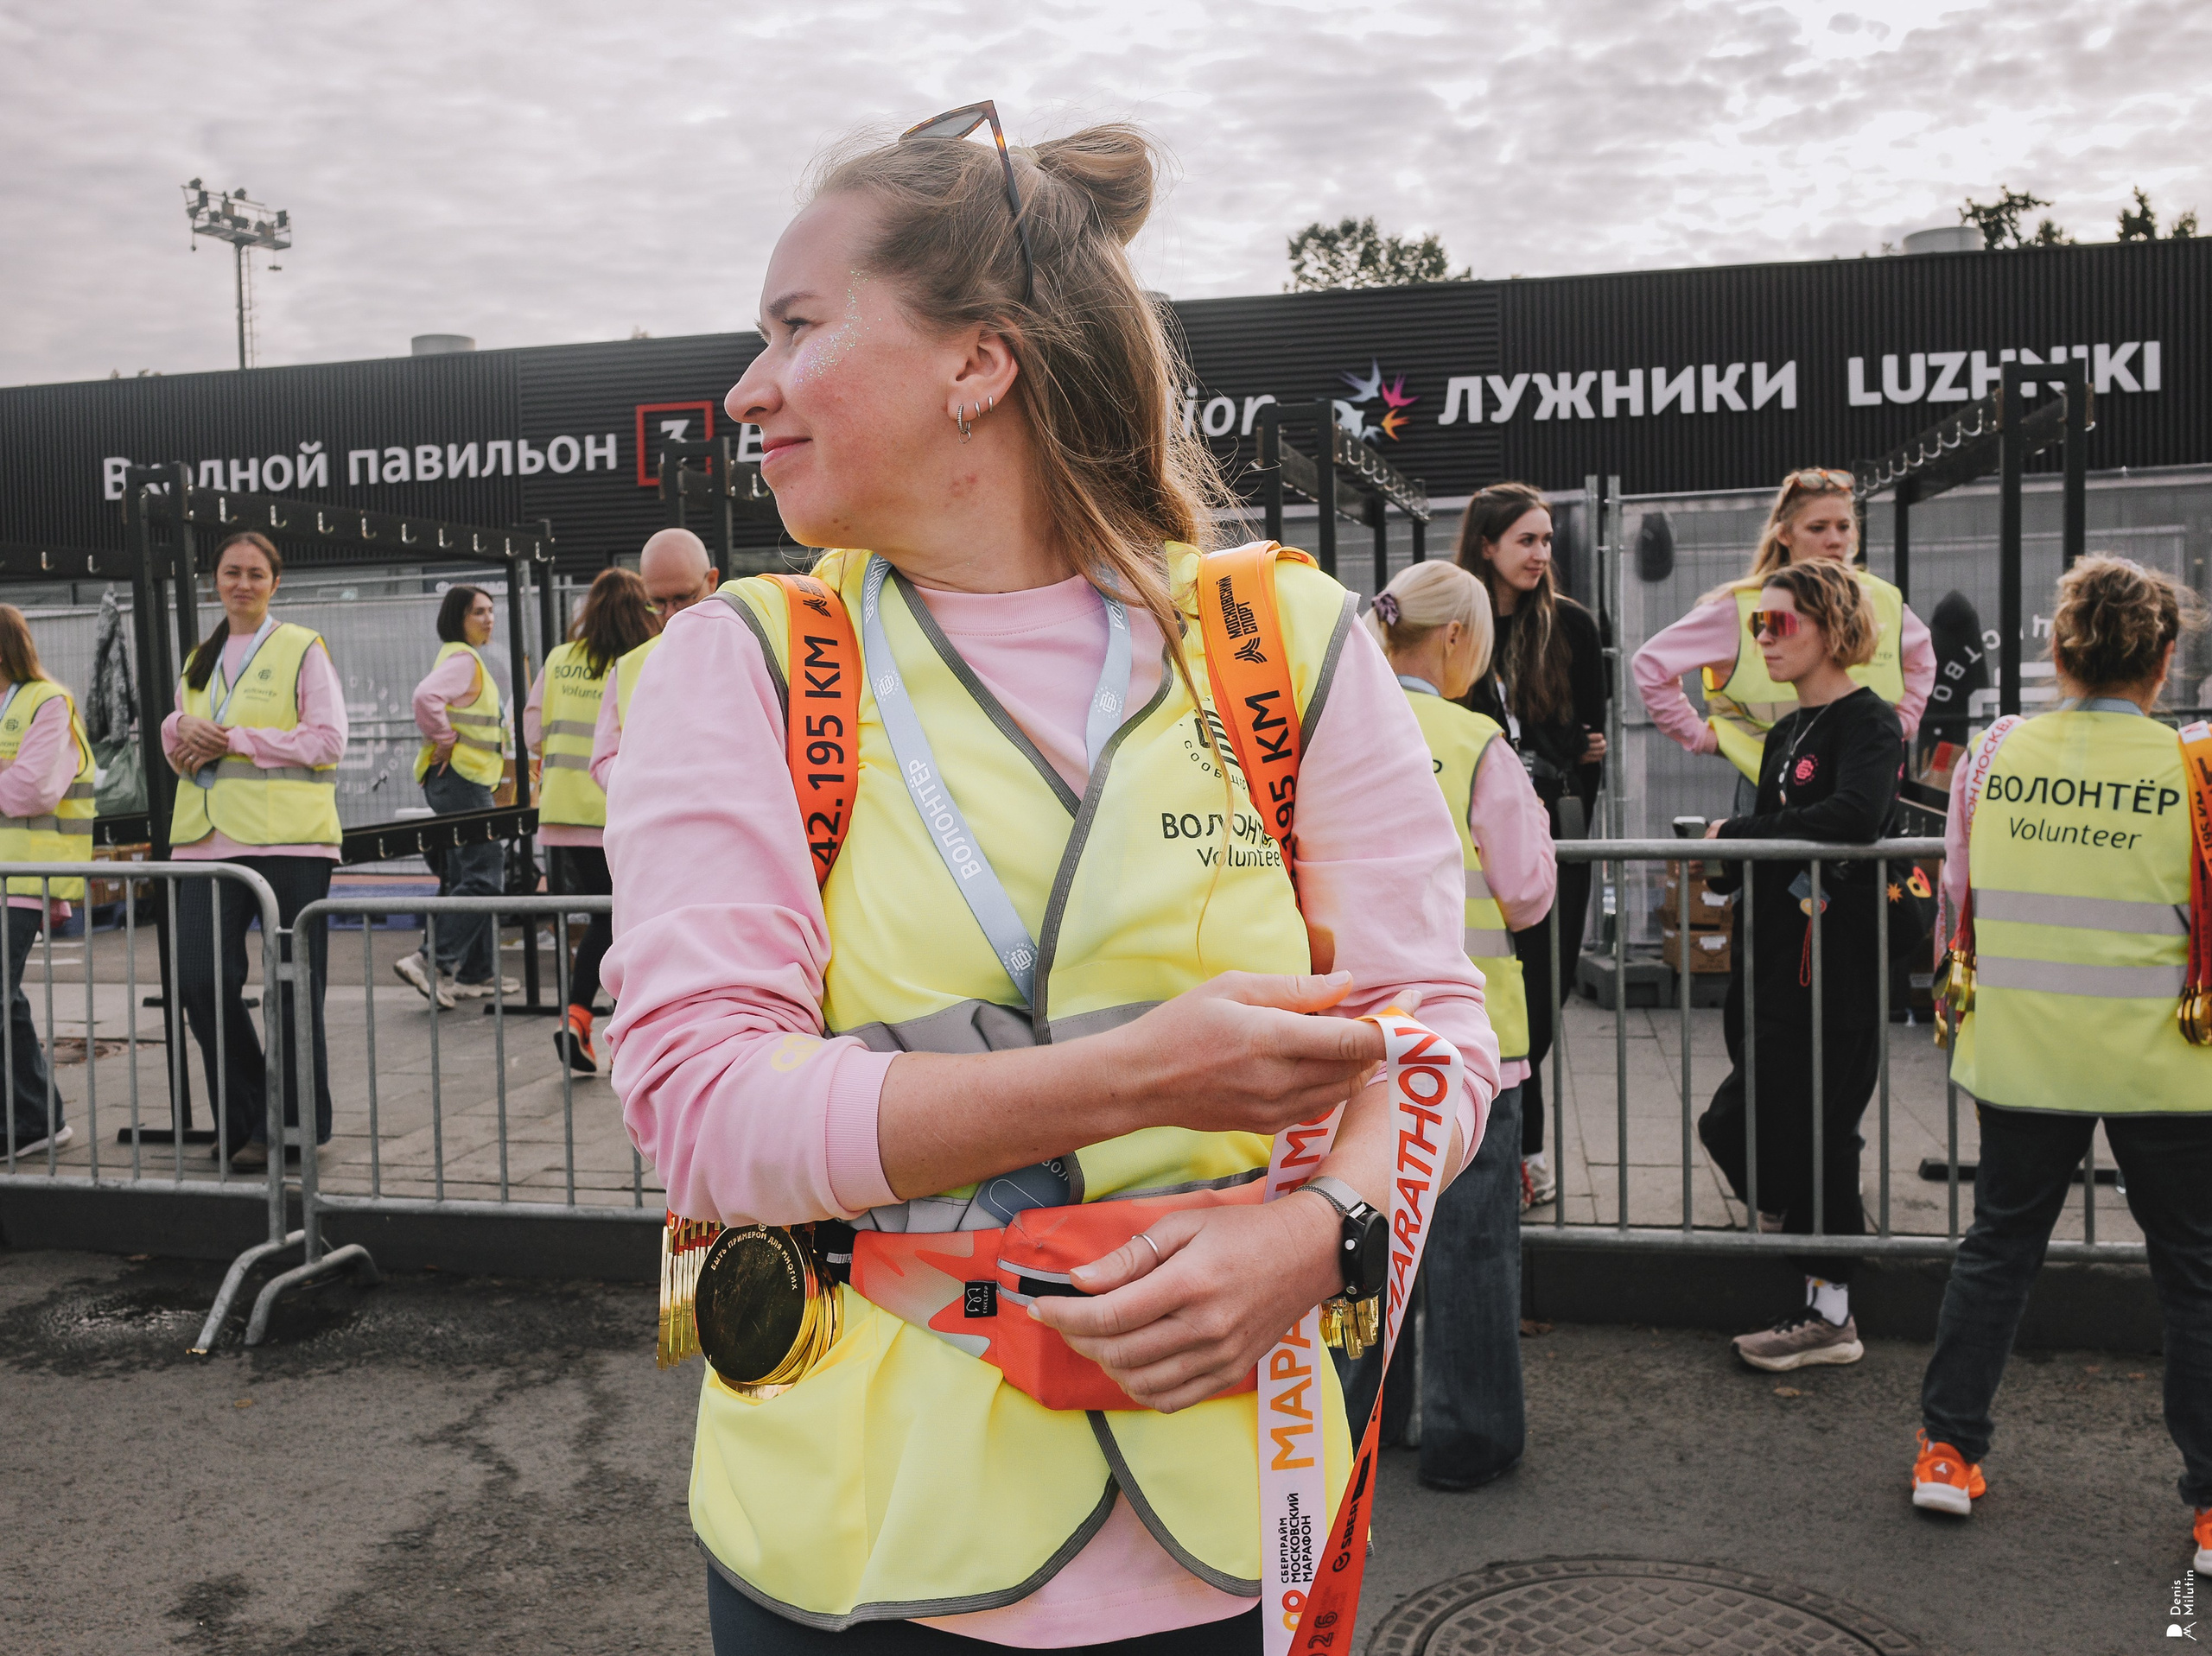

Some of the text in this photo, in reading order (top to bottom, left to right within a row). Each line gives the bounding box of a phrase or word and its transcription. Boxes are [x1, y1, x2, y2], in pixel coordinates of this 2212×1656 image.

[1438, 359, 1797, 425] ЛУЖНИКИ
[348, 433, 617, 485] павильон
[1216, 574, 1243, 640] МОСКОВСКИЙ
[1236, 601, 1259, 636] СПОРТ
[1973, 719, 2014, 785] МОСКВА
[805, 714, 845, 865] 42.195
[908, 759, 982, 880] ВОЛОНТЁР
[1986, 775, 2180, 815] ВОЛОНТЁР
[2010, 817, 2142, 849] Volunteer
[1387, 1027, 1451, 1341] MARATHON
[710, 1231, 798, 1290] БЫТЬ ПРИМЕРОМ ДЛЯ МНОГИХ
[1278, 1517, 1289, 1583] СБЕРПРАЙМ
[1287, 1492, 1301, 1583] МОСКОВСКИЙ
[1300, 1515, 1313, 1583] МАРАФОН
[1341, 1501, 1359, 1550] SBER
